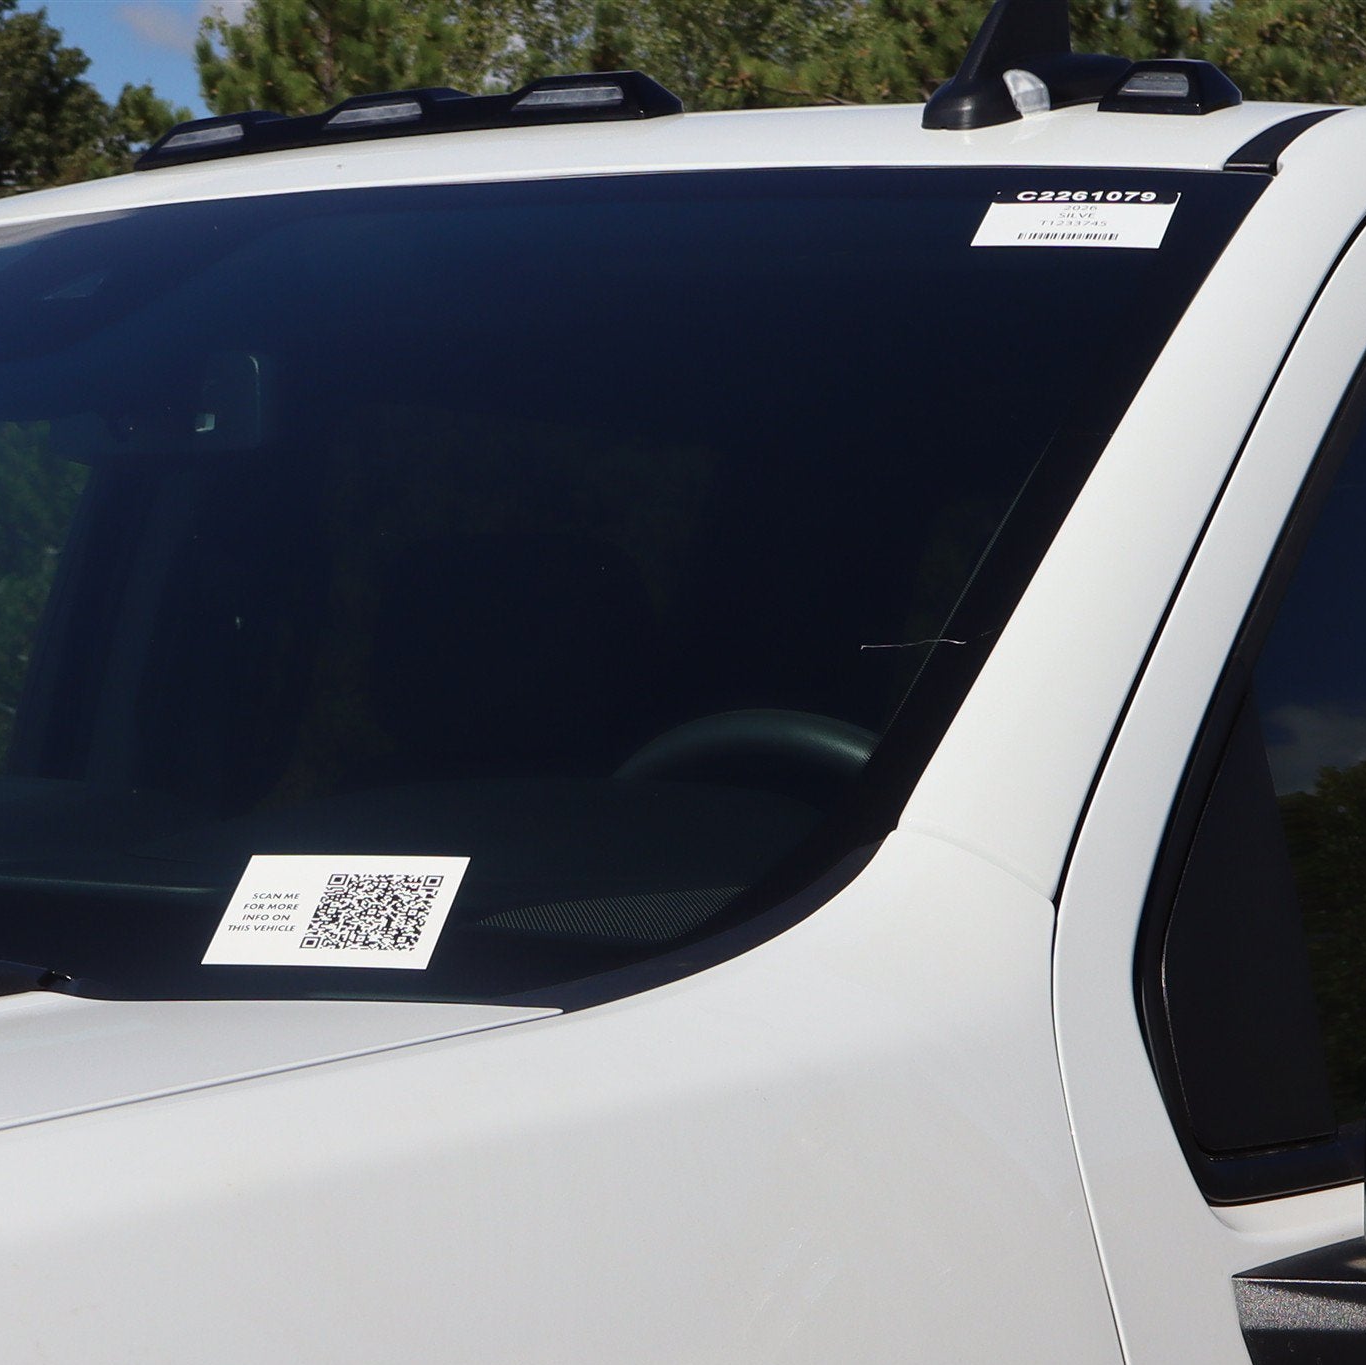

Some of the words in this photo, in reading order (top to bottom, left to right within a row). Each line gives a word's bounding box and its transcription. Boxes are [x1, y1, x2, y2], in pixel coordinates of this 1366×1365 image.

[1016, 190, 1157, 202] C2261079
[252, 892, 283, 900] SCAN
[283, 892, 301, 900] ME
[241, 913, 270, 921] INFO
[227, 924, 251, 932] THIS
[253, 924, 296, 932] VEHICLE
